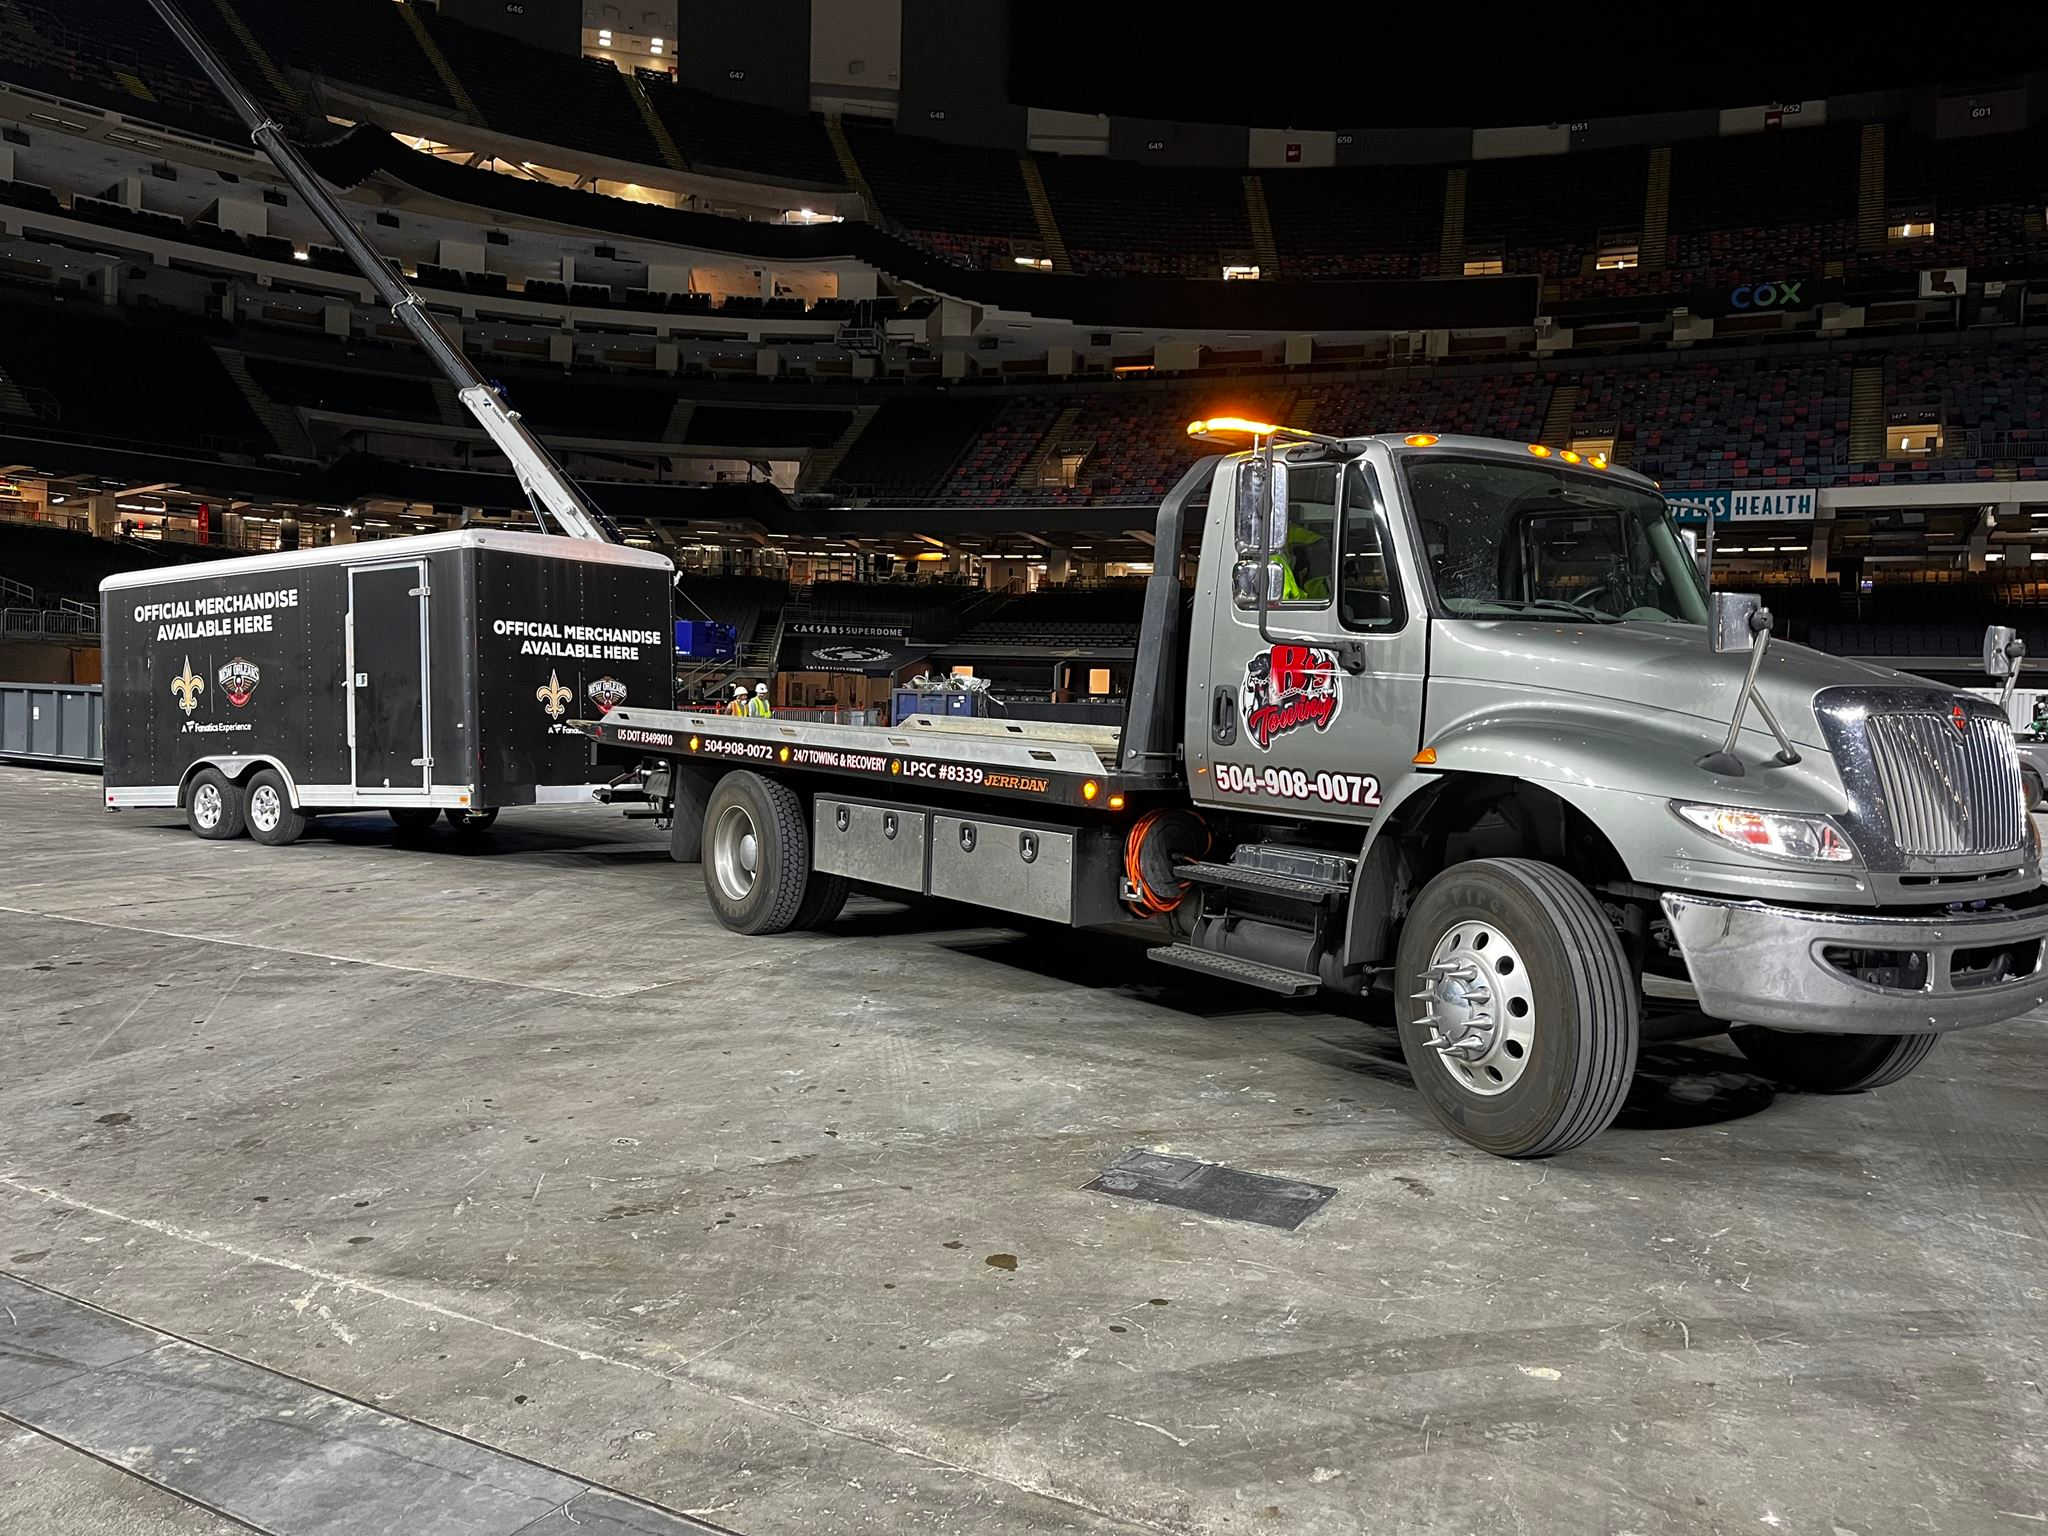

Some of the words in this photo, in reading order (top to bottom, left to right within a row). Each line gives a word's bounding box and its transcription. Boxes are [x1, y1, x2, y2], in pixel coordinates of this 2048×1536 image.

[507, 4, 523, 14] 646
[729, 71, 744, 80] 647
[930, 111, 945, 119] 648
[1783, 104, 1800, 113] 652
[1972, 107, 1991, 118] 601
[1571, 122, 1588, 131] 651
[1148, 141, 1163, 150] 649
[1337, 135, 1352, 143] 650
[1731, 281, 1802, 309] COX
[1735, 494, 1811, 516] HEALTH
[134, 600, 194, 622] OFFICIAL
[195, 588, 298, 616] MERCHANDISE
[156, 618, 232, 641] AVAILABLE
[234, 614, 273, 634] HERE
[493, 619, 562, 639] OFFICIAL
[564, 625, 661, 645] MERCHANDISE
[793, 624, 844, 635] CAESARS
[846, 626, 903, 637] SUPERDOME
[520, 640, 601, 659] AVAILABLE
[604, 645, 639, 660] HERE
[219, 666, 232, 682] NEW
[233, 663, 260, 681] ORLEANS
[588, 682, 602, 696] NEW
[603, 681, 627, 696] ORLEANS
[195, 723, 218, 733] Fanatics
[219, 722, 252, 734] Experience
[1251, 694, 1336, 745] Towing
[617, 729, 626, 740] US
[628, 730, 641, 741] DOT
[641, 732, 673, 746] #3499010
[704, 739, 773, 759] 504-908-0072
[793, 748, 809, 762] 24/7
[809, 751, 838, 766] TOWING
[839, 754, 846, 767] &
[846, 754, 887, 772] RECOVERY
[903, 760, 936, 779] LPSC
[939, 765, 983, 784] #8339
[1215, 763, 1382, 805] 504-908-0072
